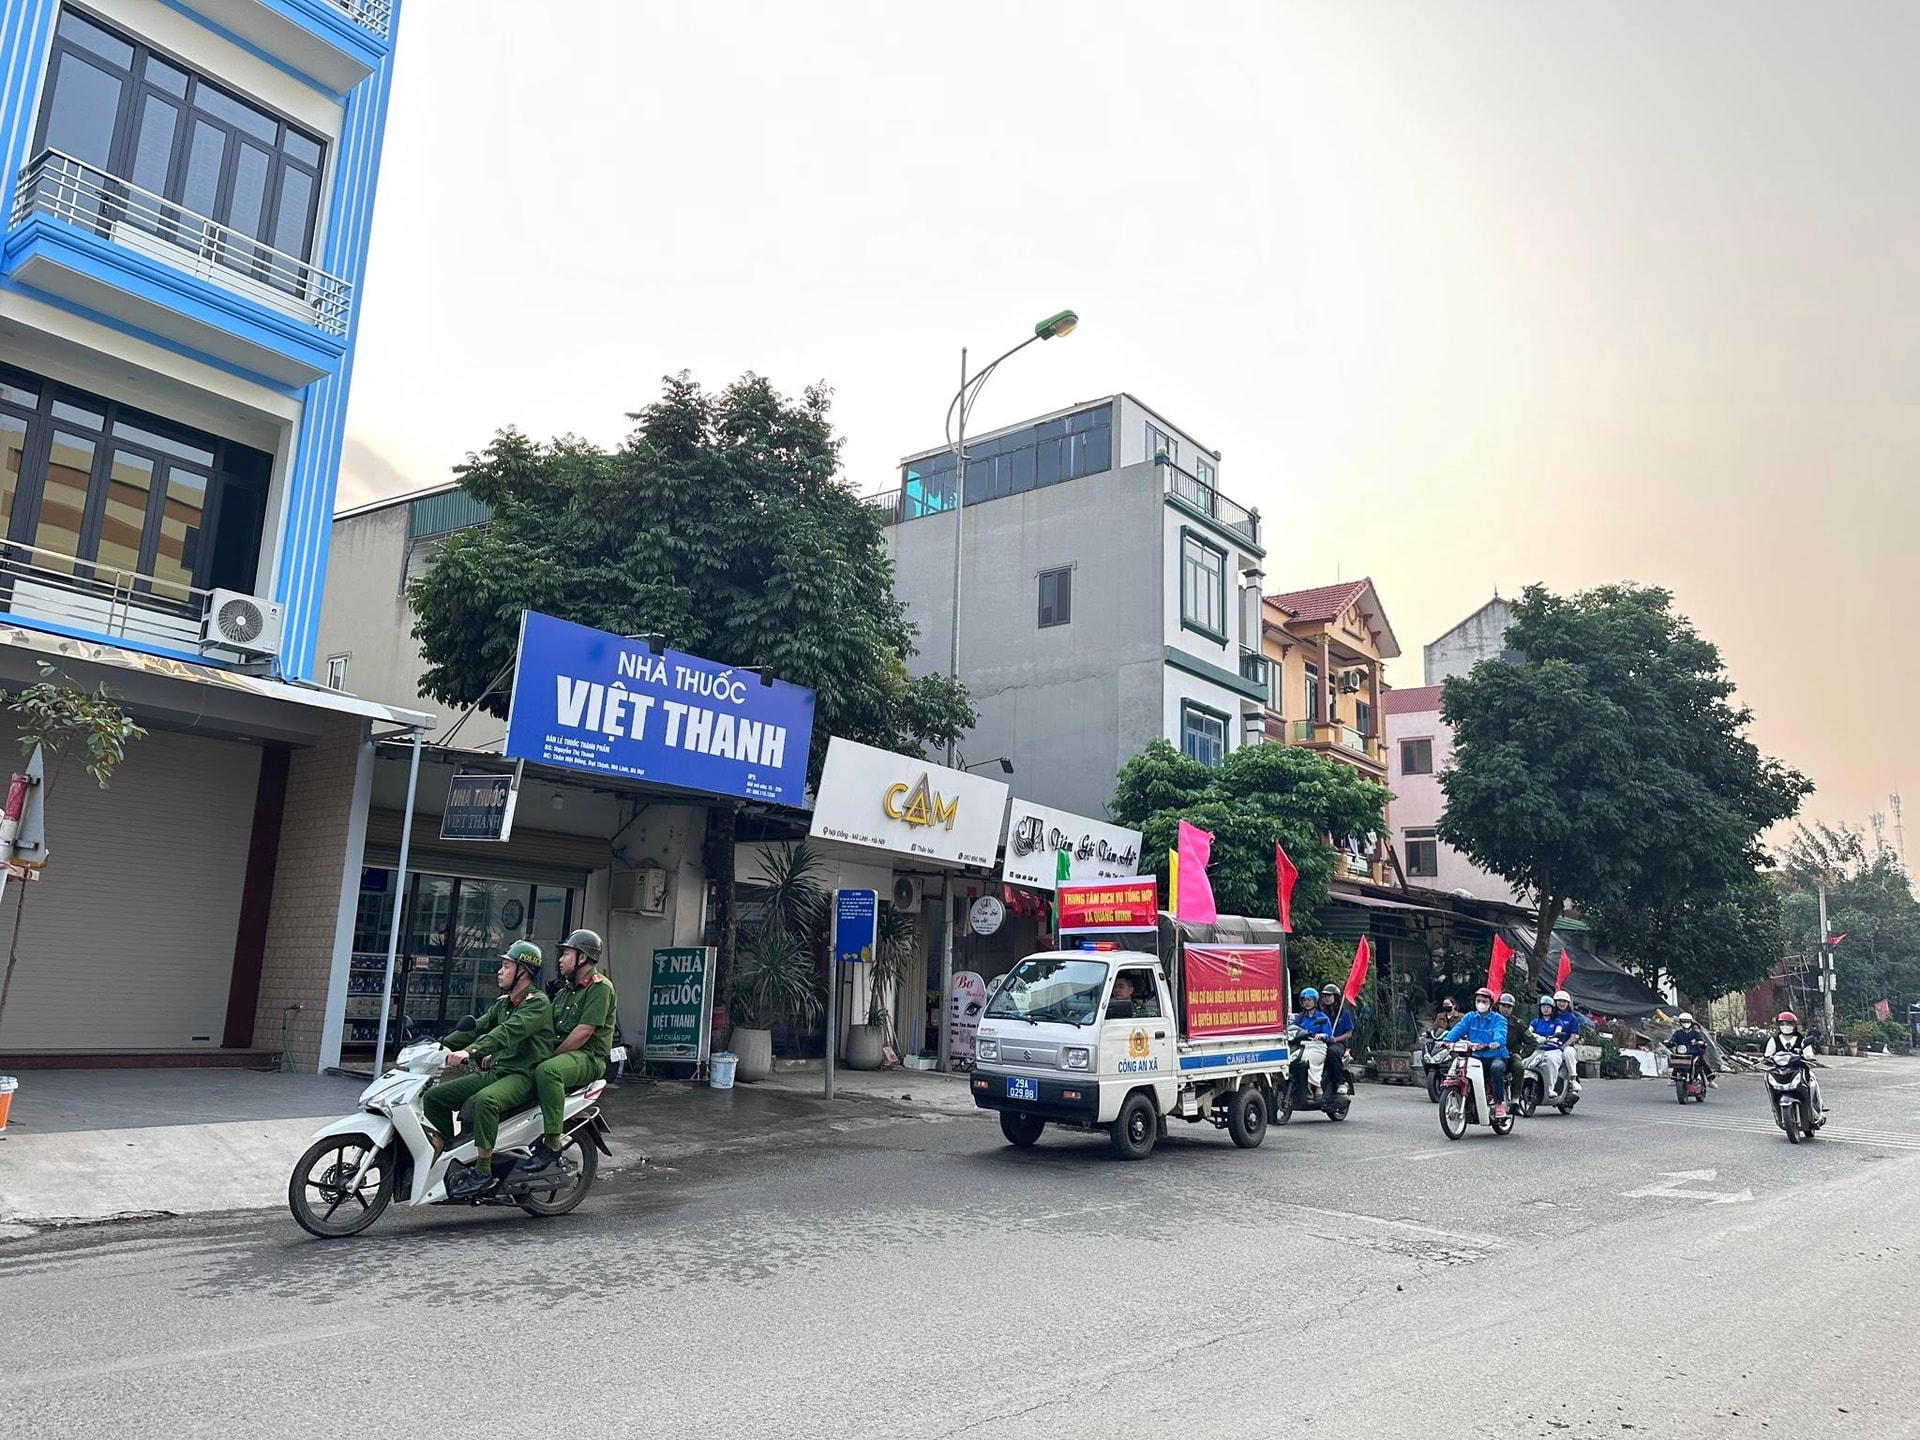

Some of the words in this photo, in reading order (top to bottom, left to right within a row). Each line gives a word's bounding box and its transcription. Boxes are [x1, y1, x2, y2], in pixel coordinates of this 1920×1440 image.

[617, 651, 668, 686] NHÀ
[676, 669, 746, 704] THUỐC
[557, 674, 655, 742] VIỆT
[663, 700, 787, 769] THANH
[450, 784, 472, 806] NHÀ
[472, 781, 506, 807] THUỐC
[468, 814, 502, 828] THANH
[1064, 893, 1086, 906] TRUNG
[1086, 890, 1100, 904] TÂM
[1100, 892, 1114, 906] DỊCH
[1124, 886, 1140, 903] TỔNG
[1094, 910, 1114, 923] QUANG
[670, 950, 703, 973] NHÀ
[652, 974, 700, 1006] THUỐC
[652, 1012, 668, 1030] VIỆT
[670, 1014, 696, 1028] THANH
[1118, 1058, 1136, 1073] CÔNG
[1138, 1060, 1148, 1072] AN
[1148, 1056, 1158, 1070] XÃ
[1226, 1052, 1246, 1065] CẢNH
[1246, 1051, 1260, 1064] SÁT
[1015, 1078, 1028, 1088] 29A
[1010, 1087, 1034, 1098] 029.88
